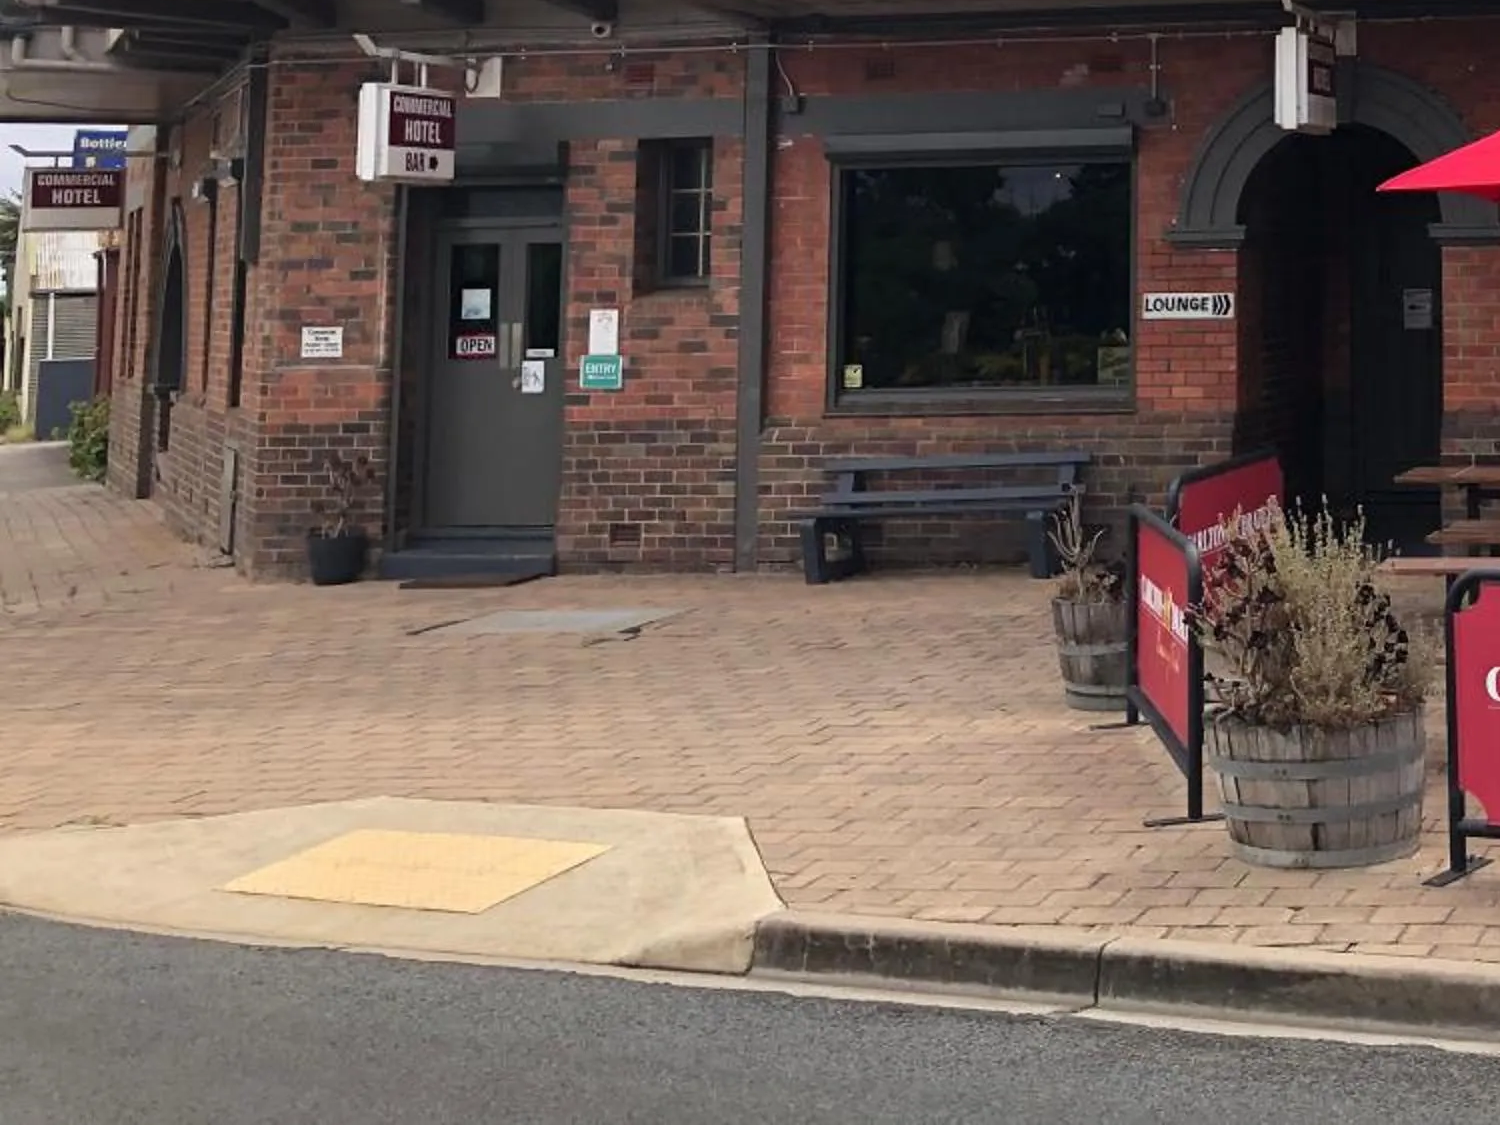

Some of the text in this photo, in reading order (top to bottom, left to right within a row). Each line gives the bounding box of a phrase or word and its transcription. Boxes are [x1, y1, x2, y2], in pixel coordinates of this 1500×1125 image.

[405, 118, 441, 145] HOTEL
[405, 152, 425, 172] BAR
[51, 188, 101, 205] HOTEL
[1145, 296, 1209, 312] LOUNGE
[461, 338, 494, 353] OPEN
[585, 362, 617, 375] ENTRY
